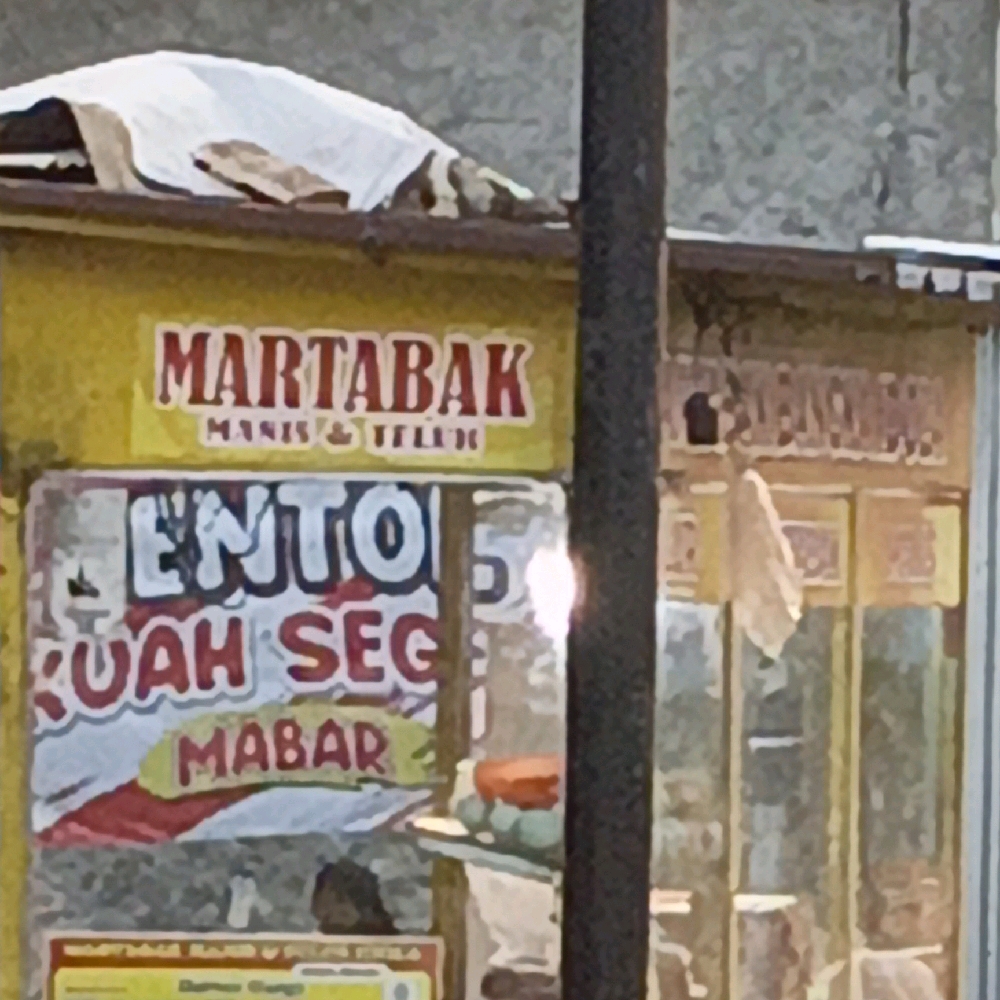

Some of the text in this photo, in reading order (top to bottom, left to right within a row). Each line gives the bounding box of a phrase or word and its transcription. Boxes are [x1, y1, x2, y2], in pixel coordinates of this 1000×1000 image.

[157, 328, 530, 418] MARTABAK
[130, 484, 441, 598] ENTO
[177, 718, 389, 788] MABAR
